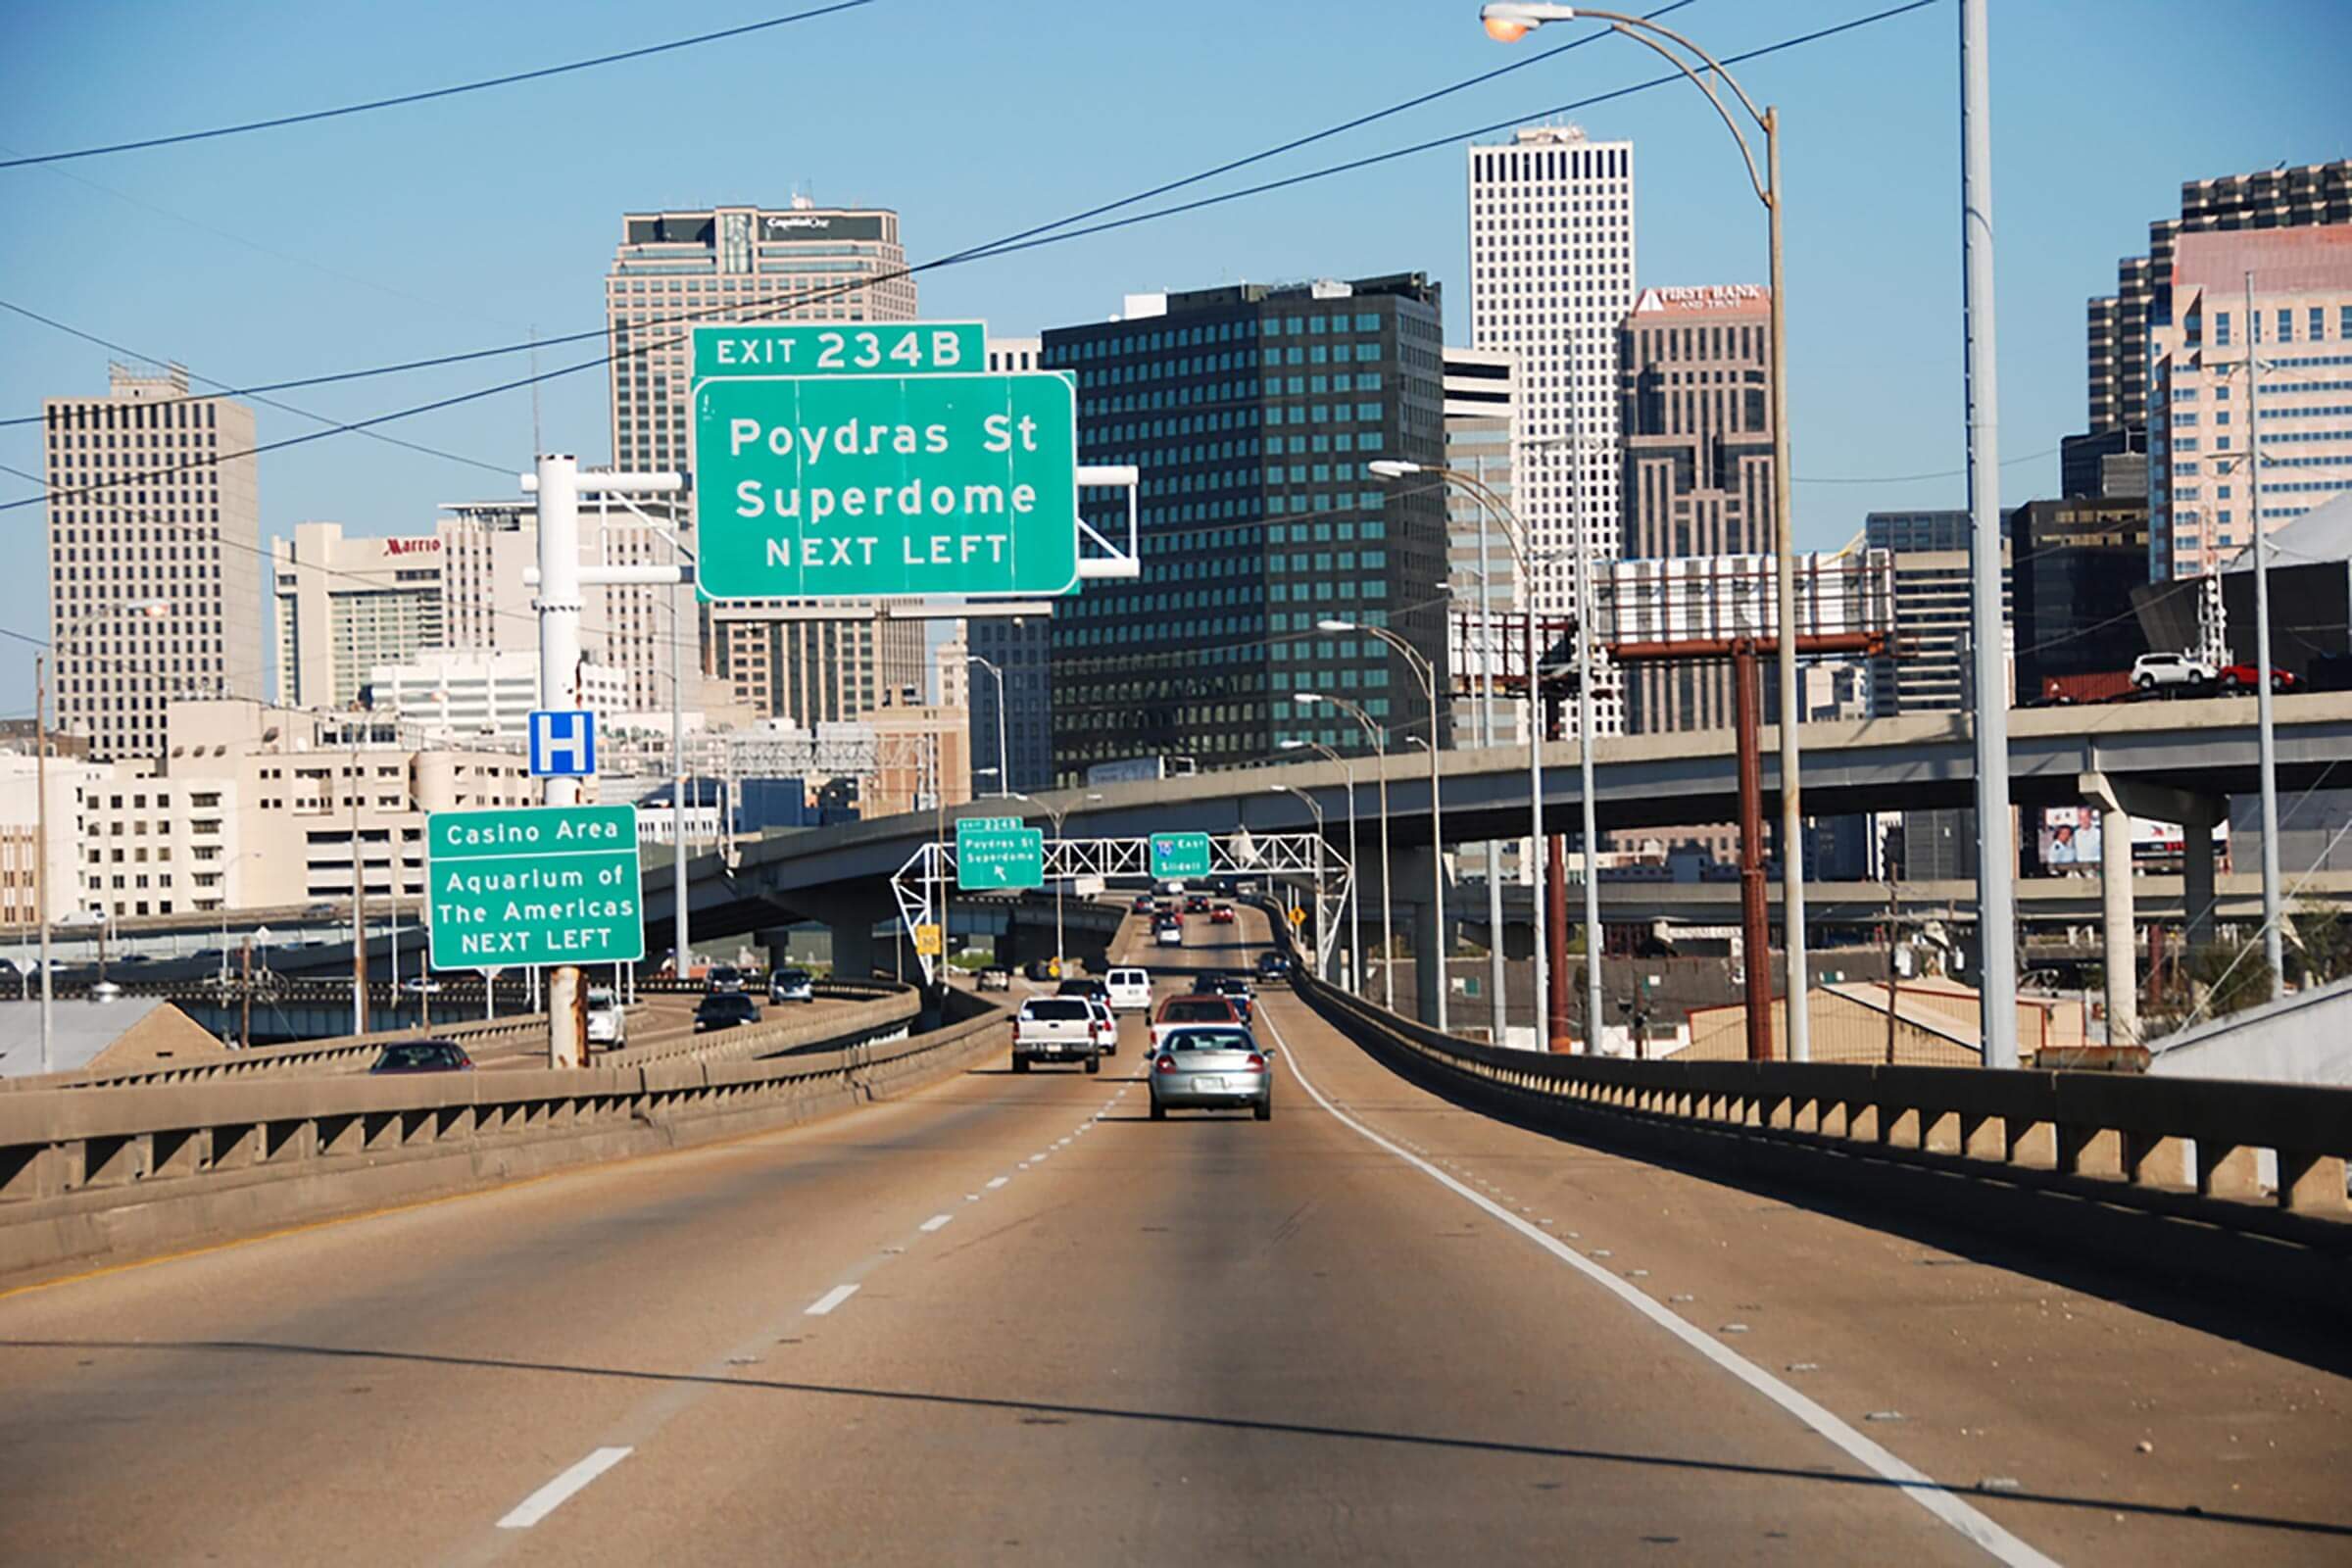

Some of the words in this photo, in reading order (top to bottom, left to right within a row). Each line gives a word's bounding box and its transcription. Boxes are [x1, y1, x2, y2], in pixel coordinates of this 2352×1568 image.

[1661, 286, 1704, 301] FIRST
[1709, 283, 1759, 300] BANK
[717, 338, 796, 364] EXIT
[817, 330, 960, 368] 234B
[731, 417, 949, 466] Poydras
[983, 415, 1037, 453] St
[736, 478, 1036, 525] Superdome
[383, 538, 441, 557] Marrio
[766, 537, 878, 566] NEXT
[904, 534, 1007, 564] LEFT
[538, 714, 586, 772] H
[447, 823, 539, 845] Casino
[556, 820, 617, 839] Area
[446, 869, 583, 895] Aquarium
[599, 864, 623, 885] of
[438, 905, 486, 923] The
[504, 899, 633, 921] Americas
[462, 931, 530, 954] NEXT
[547, 927, 612, 950] LEFT
